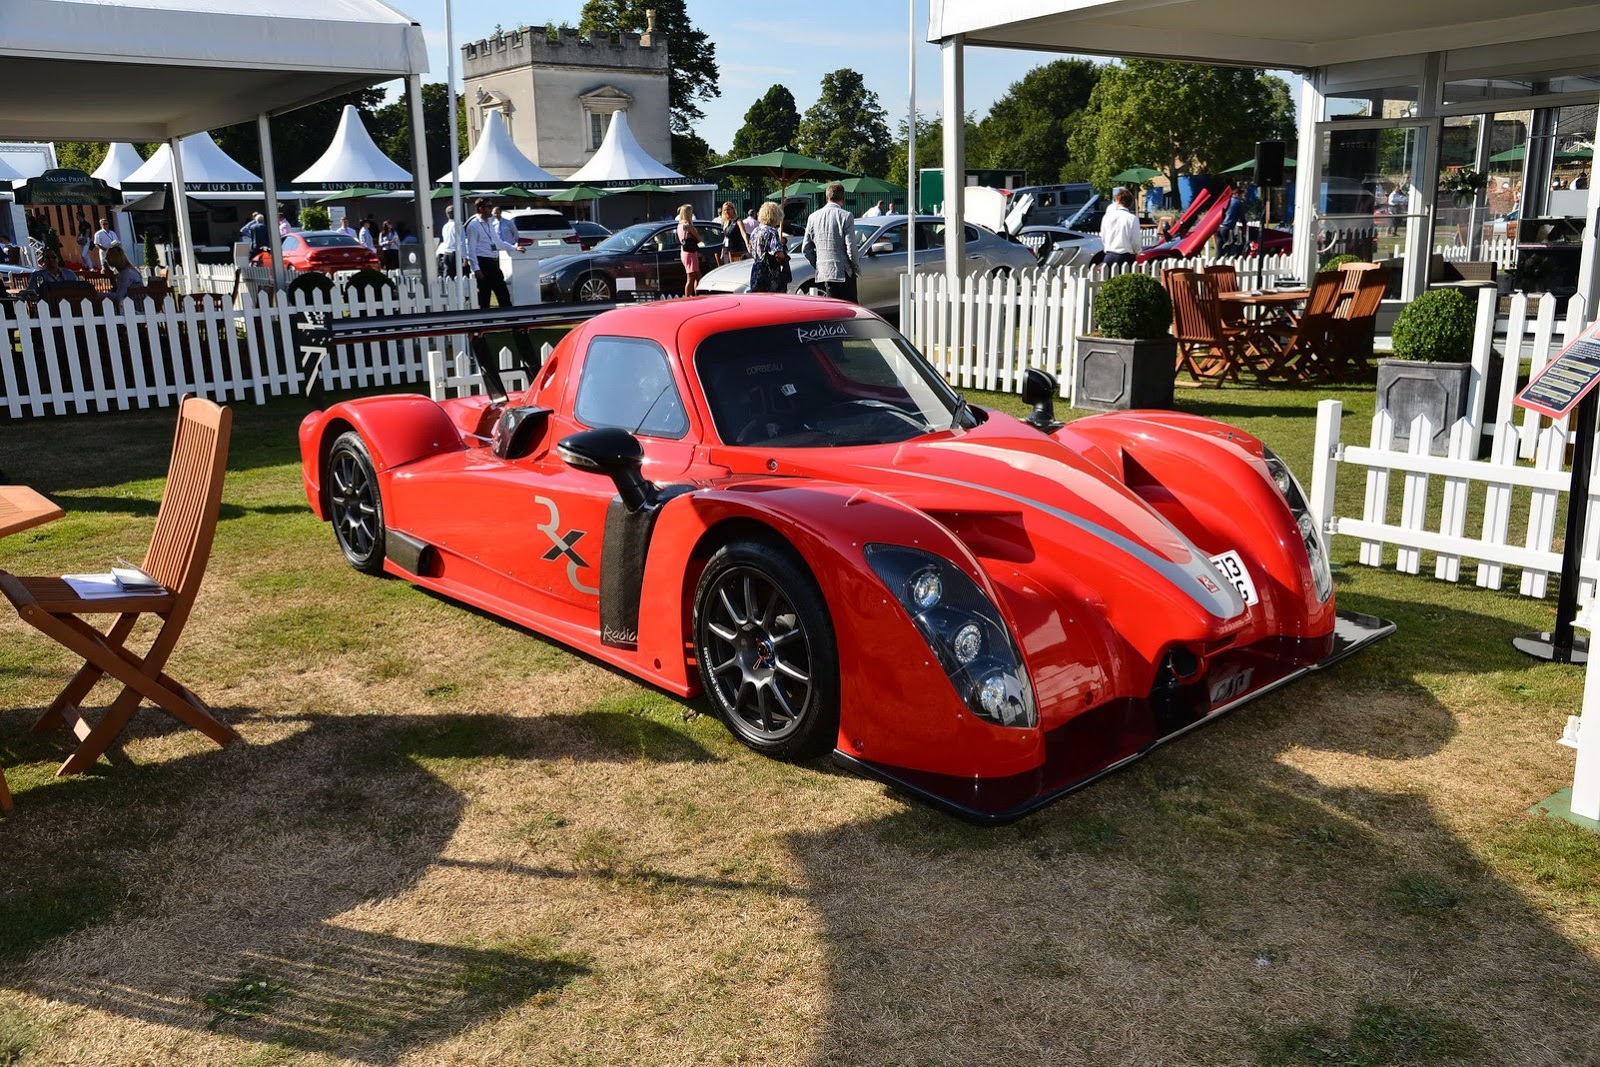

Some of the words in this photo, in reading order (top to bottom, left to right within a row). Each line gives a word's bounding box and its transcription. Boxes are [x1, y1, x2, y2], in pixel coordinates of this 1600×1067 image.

[207, 183, 231, 192] (UK)
[235, 183, 256, 191] LTD.
[796, 323, 852, 343] Radical
[745, 362, 784, 375] CORBEAU
[602, 624, 639, 644] Radic
